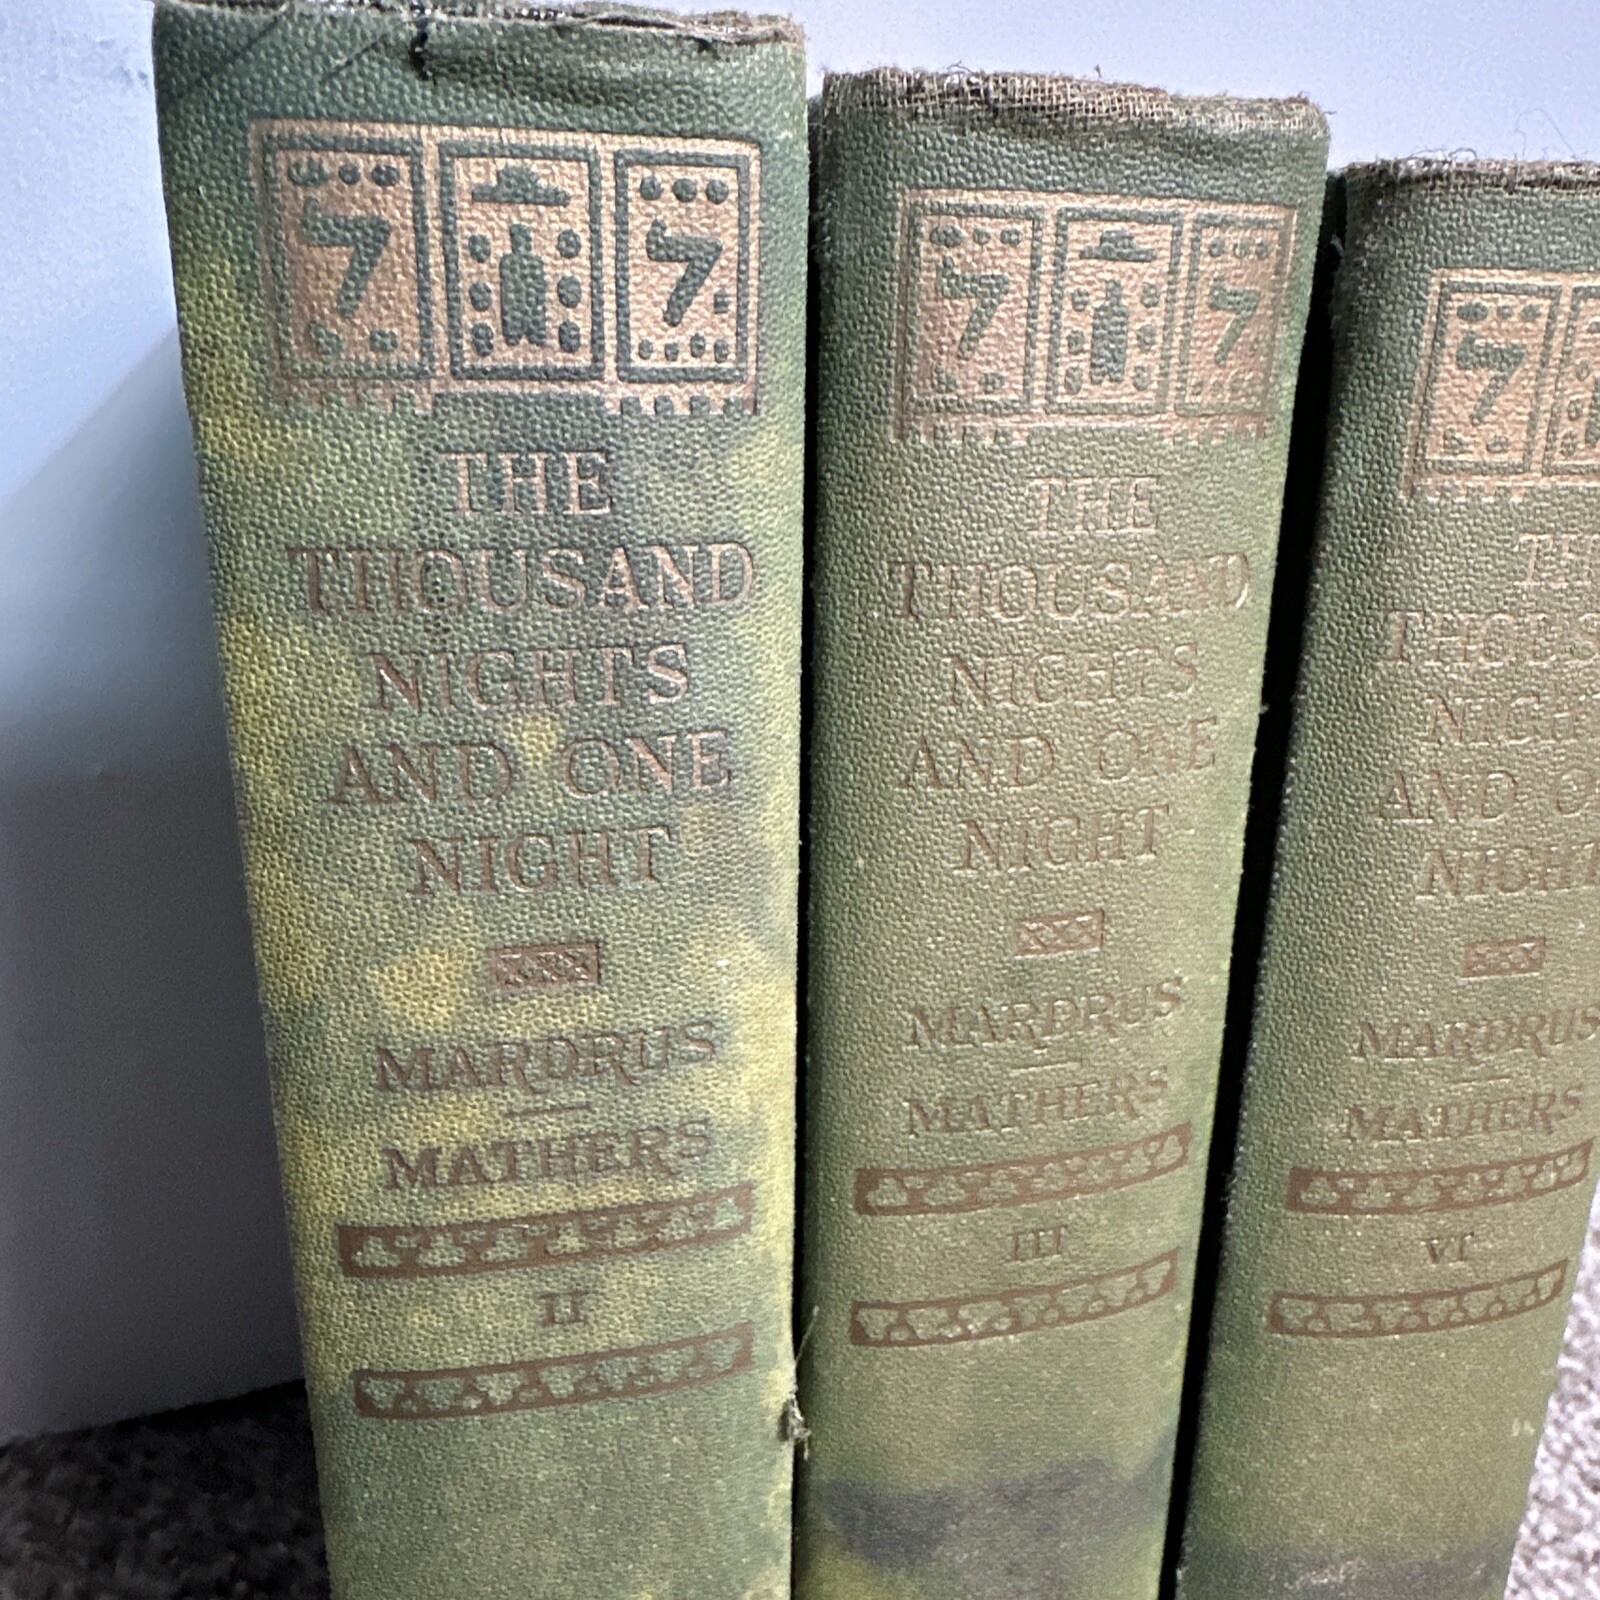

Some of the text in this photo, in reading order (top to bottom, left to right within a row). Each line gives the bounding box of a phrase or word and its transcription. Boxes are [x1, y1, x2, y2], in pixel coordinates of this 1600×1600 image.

[437, 451, 612, 517] THE
[1025, 475, 1159, 535] THE
[285, 541, 756, 616] THOUSAND
[887, 552, 1251, 621] THOUSAND
[367, 642, 691, 714] NIGHTS
[942, 641, 1200, 709] NIGHTS
[334, 727, 733, 806] AND ONE
[897, 715, 1218, 791] AND ONE
[1376, 768, 1519, 823] AND
[407, 824, 673, 898] NIGHT
[954, 804, 1170, 876] NIGHT
[901, 976, 1184, 1053] MARDRUS
[375, 1020, 718, 1096] MARDRUS
[901, 1065, 1169, 1138] MATHERS
[1345, 1084, 1583, 1143] MATHERS
[382, 1118, 712, 1191] MATHERS
[1004, 1223, 1069, 1264] III
[1420, 1231, 1476, 1266] VI
[536, 1289, 589, 1328] II
